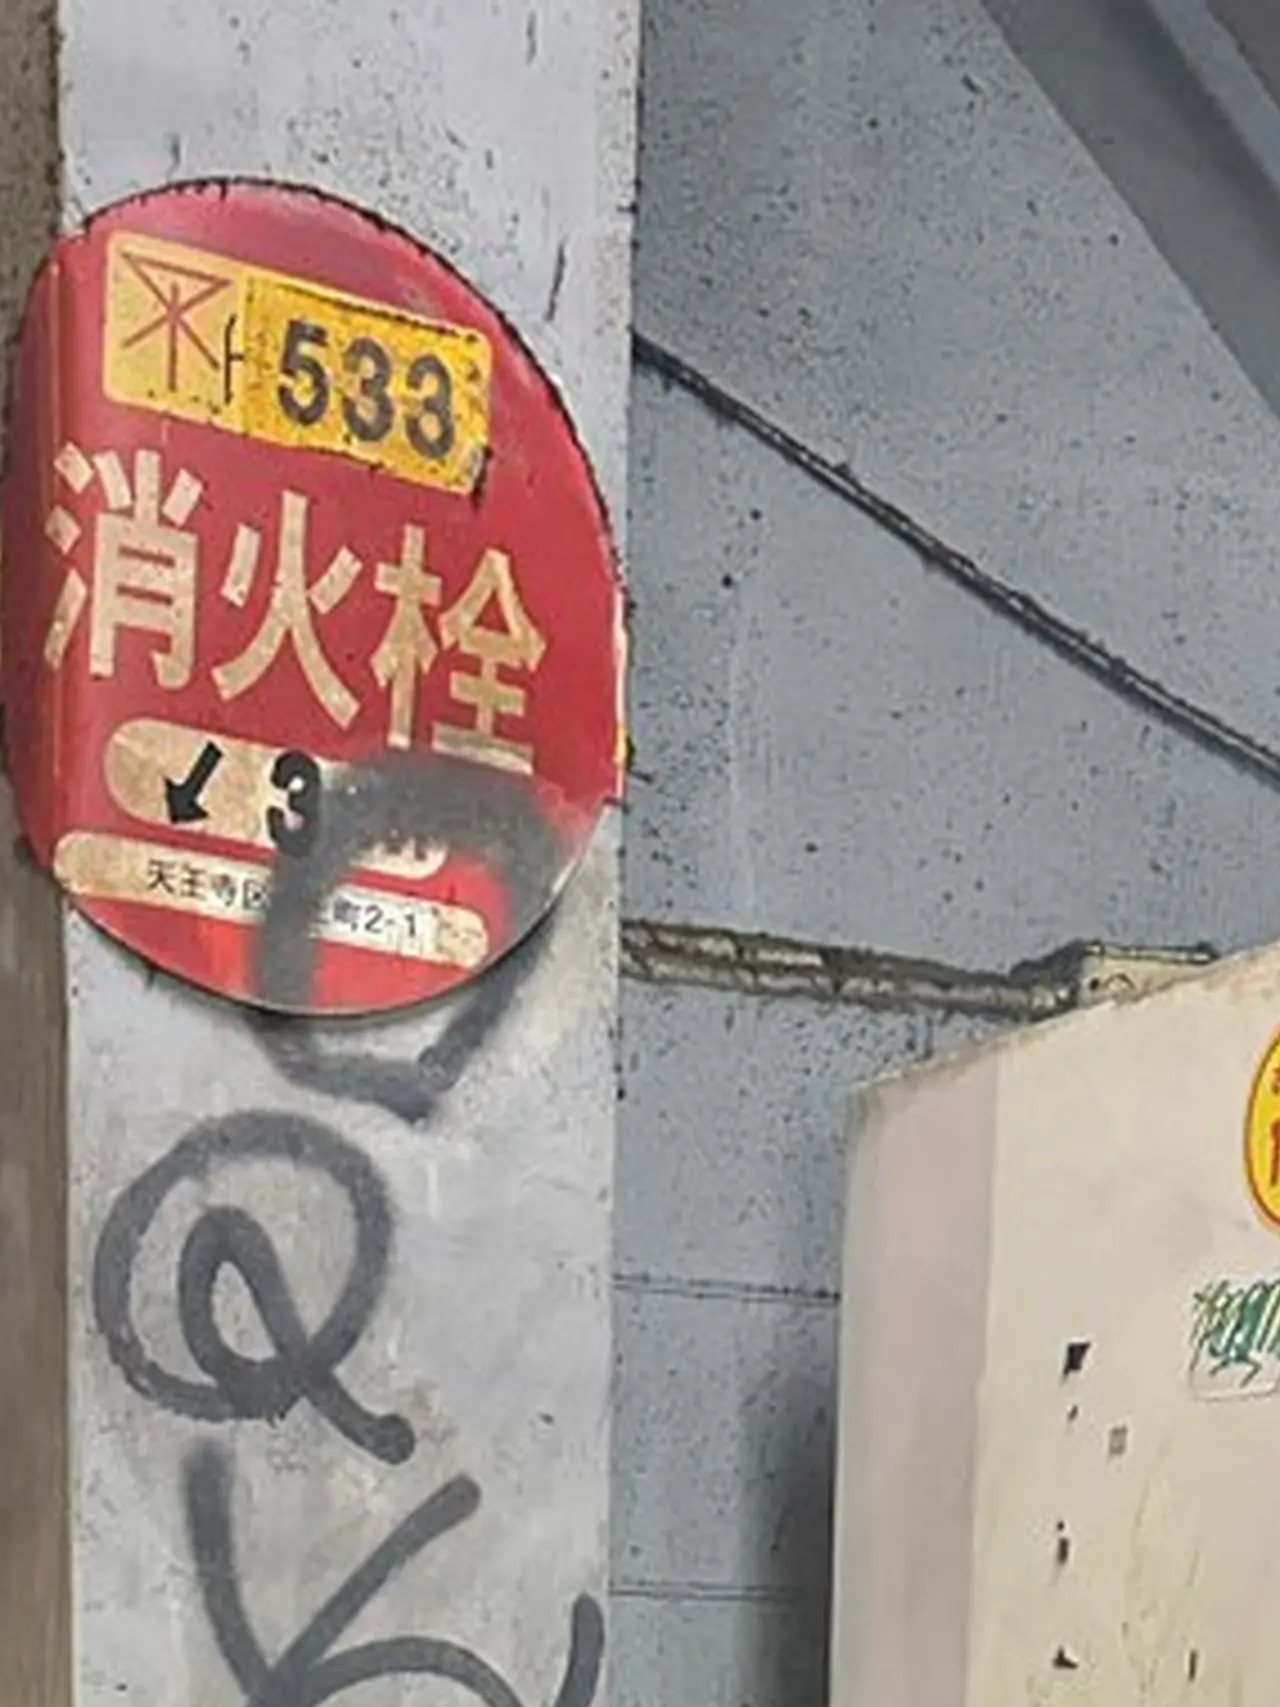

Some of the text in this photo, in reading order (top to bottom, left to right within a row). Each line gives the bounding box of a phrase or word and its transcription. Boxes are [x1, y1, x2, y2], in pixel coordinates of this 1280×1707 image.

[276, 318, 455, 461] 533
[44, 441, 547, 776] 消火栓
